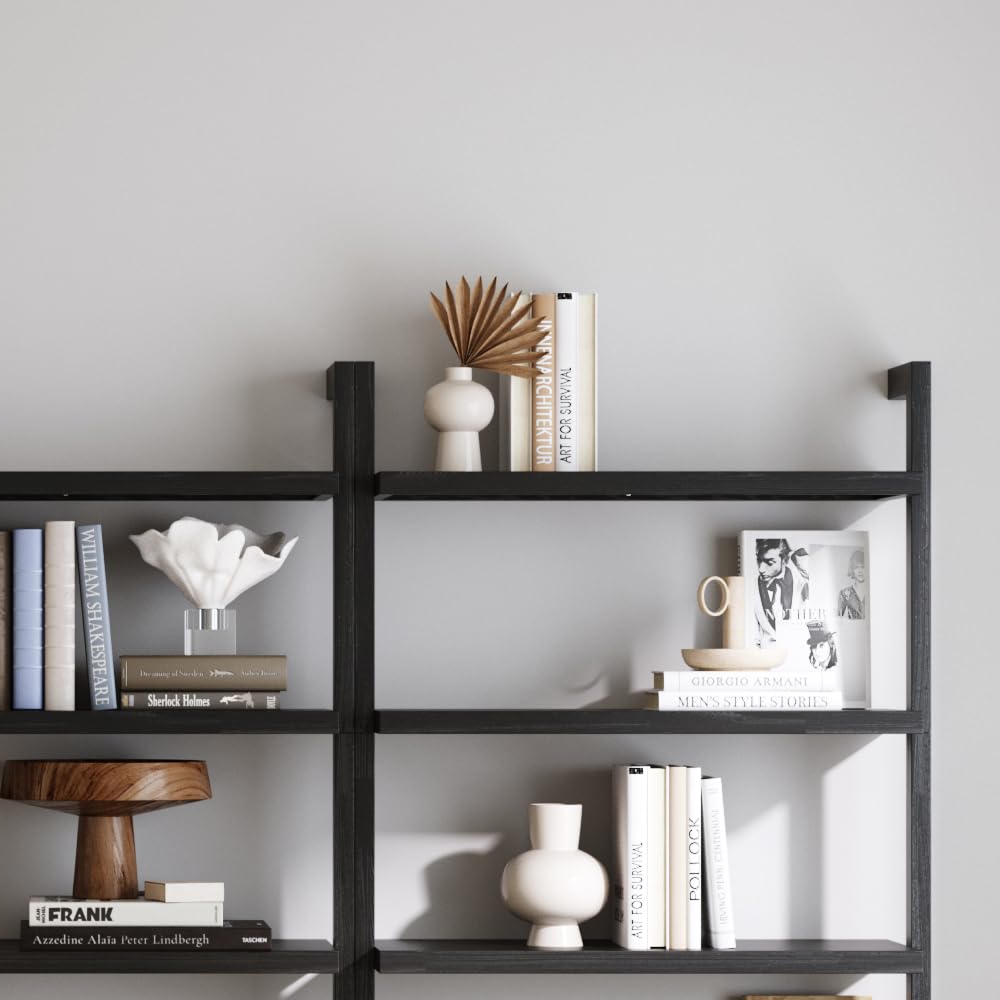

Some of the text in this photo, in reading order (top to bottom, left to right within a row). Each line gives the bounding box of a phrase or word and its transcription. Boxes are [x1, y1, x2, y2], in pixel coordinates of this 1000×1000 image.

[559, 367, 572, 464] ART FOR SURVIVAL
[79, 528, 110, 706] WILLIAM SHAKESPEARE
[691, 676, 808, 687] GIORGIO ARMANI
[147, 694, 211, 708] Sherlock Holmes
[723, 696, 768, 708] STYLE
[770, 696, 829, 708] STORIES
[688, 817, 700, 901] POLLOCK
[631, 842, 643, 939] ART FOR SURVIVAL
[48, 907, 114, 922] FRANK
[32, 934, 83, 945] Azzedine
[121, 934, 148, 945] Peter
[152, 933, 210, 948] Lindbergh
